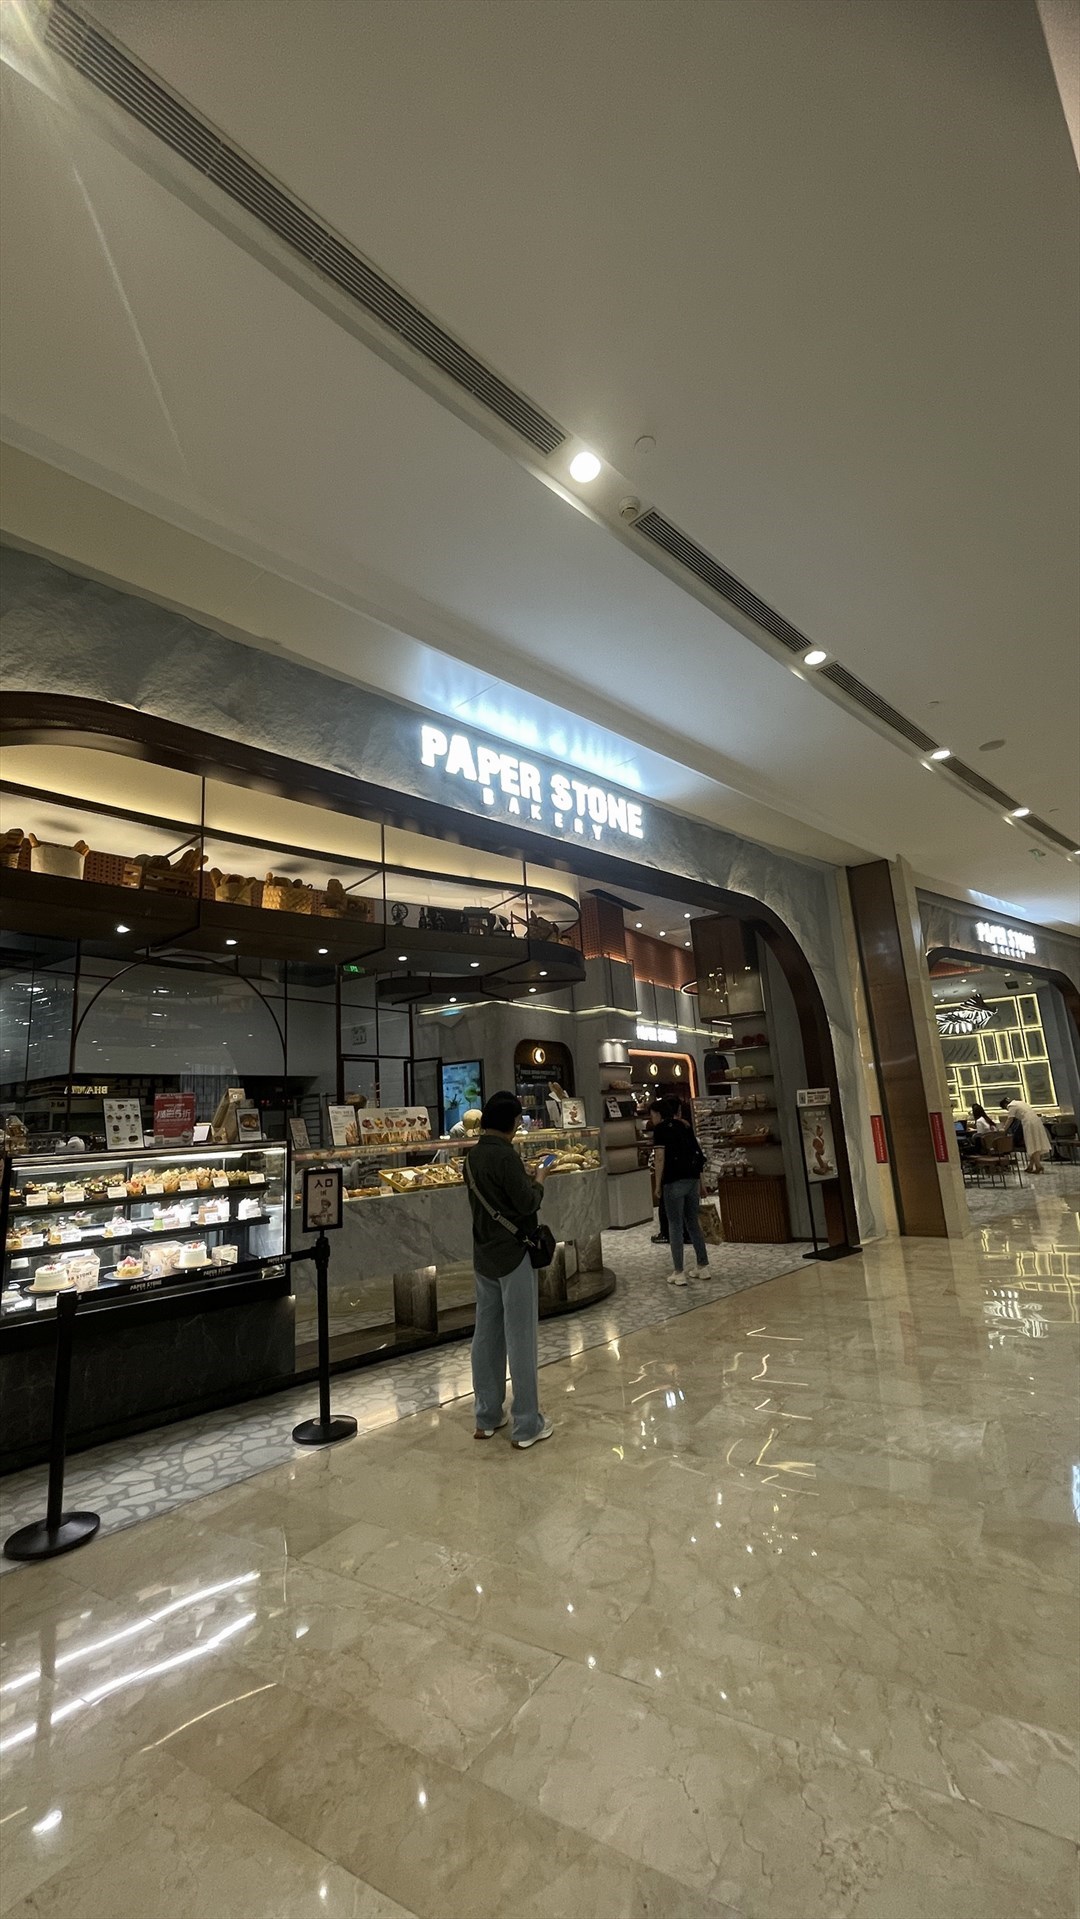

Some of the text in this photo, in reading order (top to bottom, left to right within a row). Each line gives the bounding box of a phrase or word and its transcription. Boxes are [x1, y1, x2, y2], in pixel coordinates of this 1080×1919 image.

[421, 725, 644, 839] PAPER STONE
[482, 787, 603, 841] BAKERY
[314, 1178, 333, 1189] 入口
